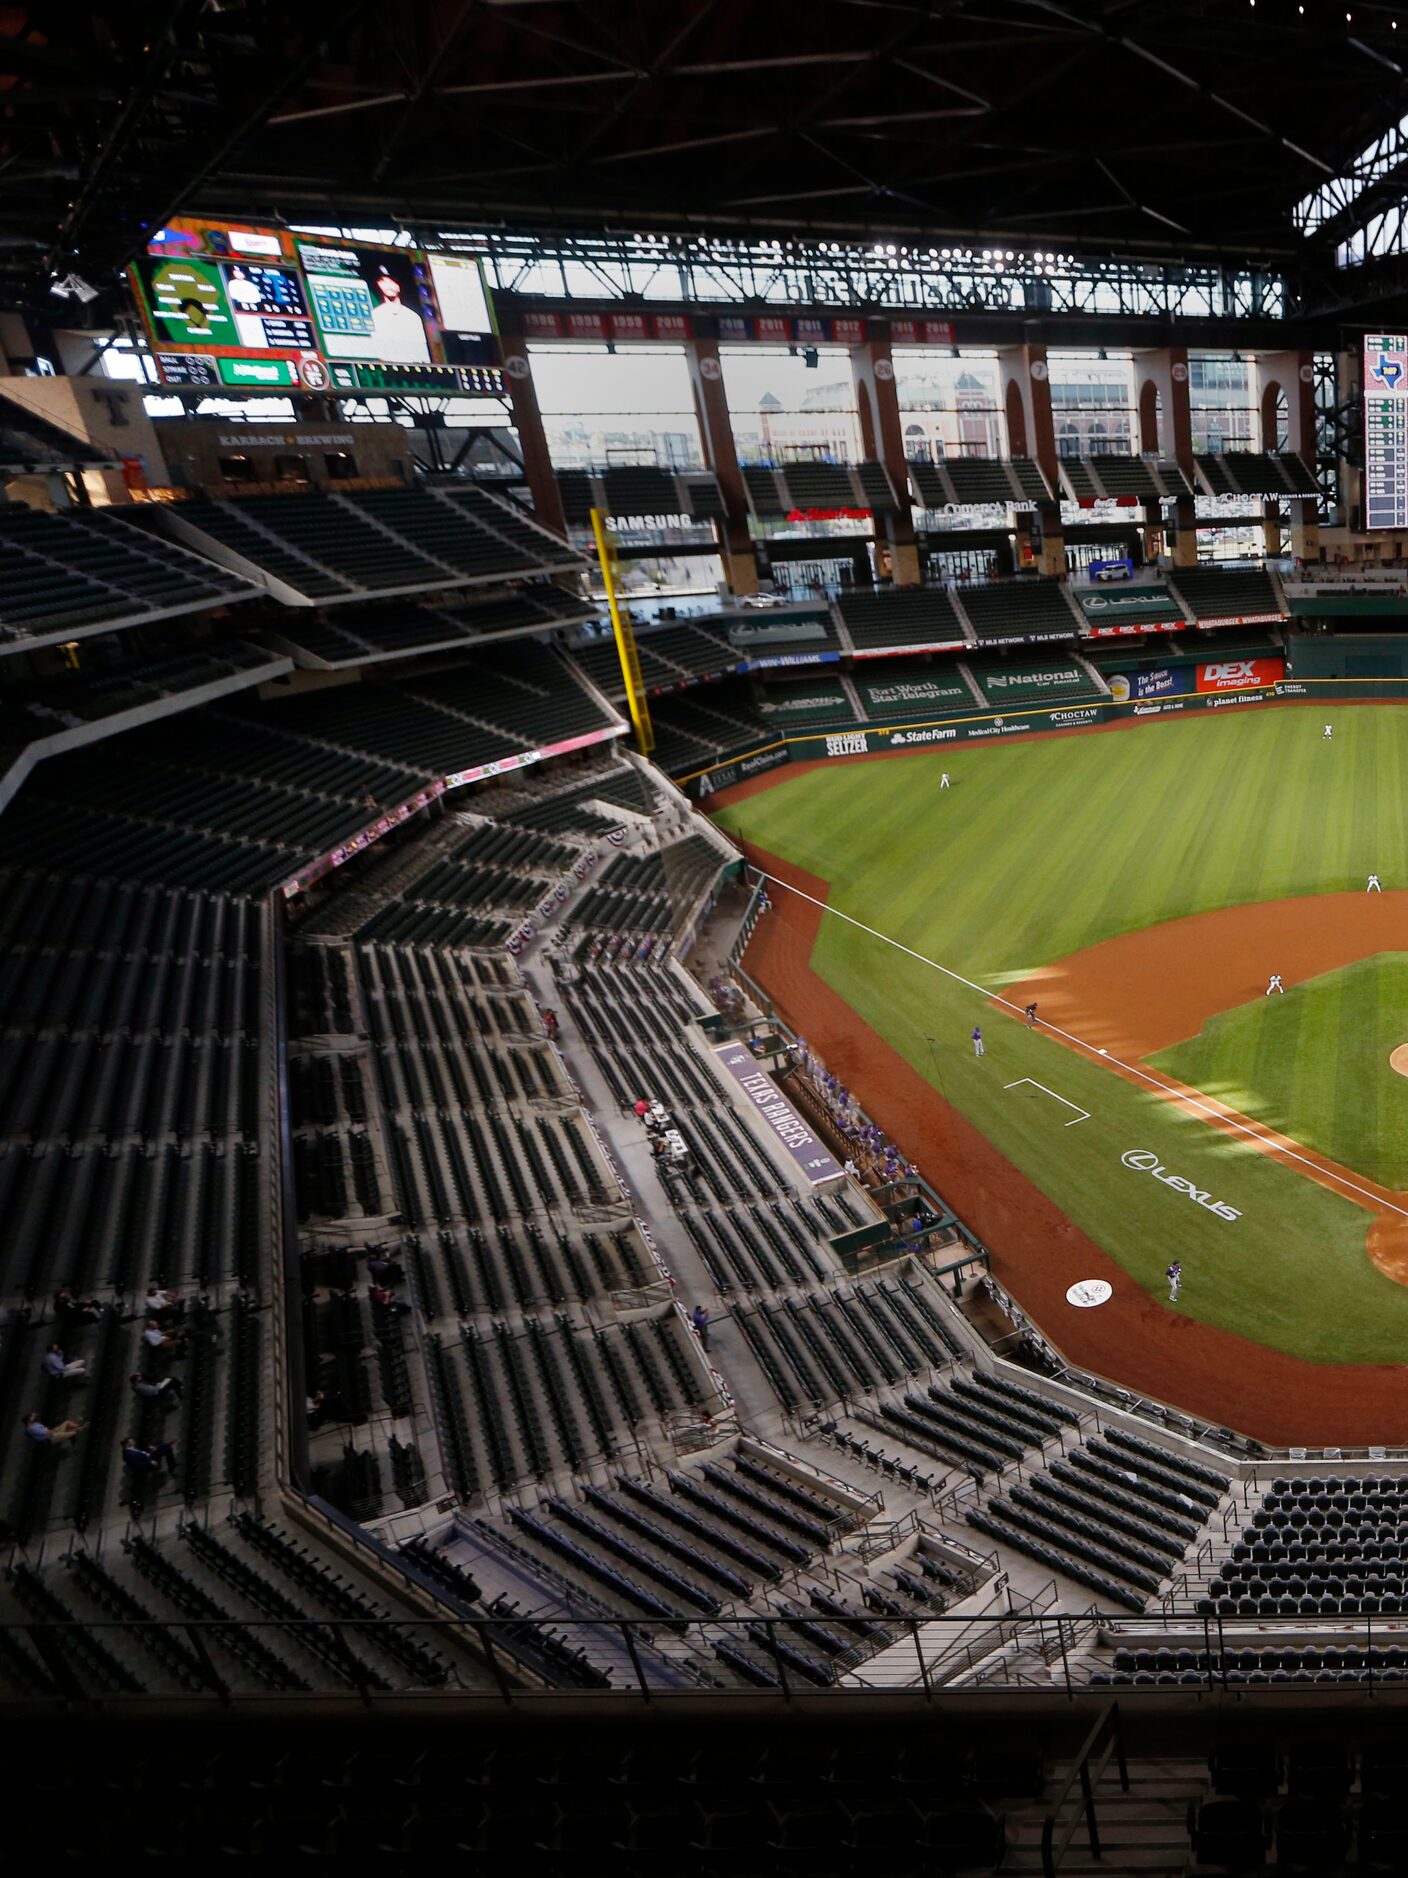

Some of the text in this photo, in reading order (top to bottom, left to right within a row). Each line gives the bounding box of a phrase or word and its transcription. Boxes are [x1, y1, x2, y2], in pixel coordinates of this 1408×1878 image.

[219, 433, 355, 445] KARBACH BREWING
[1225, 491, 1278, 502] CHOCTAW
[1005, 499, 1038, 511] Bank
[605, 512, 692, 531] SAMSUNG
[1109, 594, 1169, 604] LEXUS
[1242, 613, 1282, 623] WHATABURGER
[998, 636, 1025, 644] NETWORK
[1049, 632, 1074, 640] NETWORK
[1204, 660, 1256, 680] DEX
[1138, 675, 1149, 685] The
[1216, 675, 1261, 686] imaging
[869, 681, 938, 694] Fort Worth
[1138, 687, 1144, 696] is
[1145, 683, 1155, 694] the
[1214, 694, 1263, 706] planet fitness
[1054, 708, 1098, 720] CHOCTAW
[1001, 723, 1030, 732] Healthcare
[827, 739, 868, 756] SELTZER
[740, 1070, 813, 1150] TEXAS RANGERS
[1152, 1166, 1243, 1222] LEXUS
